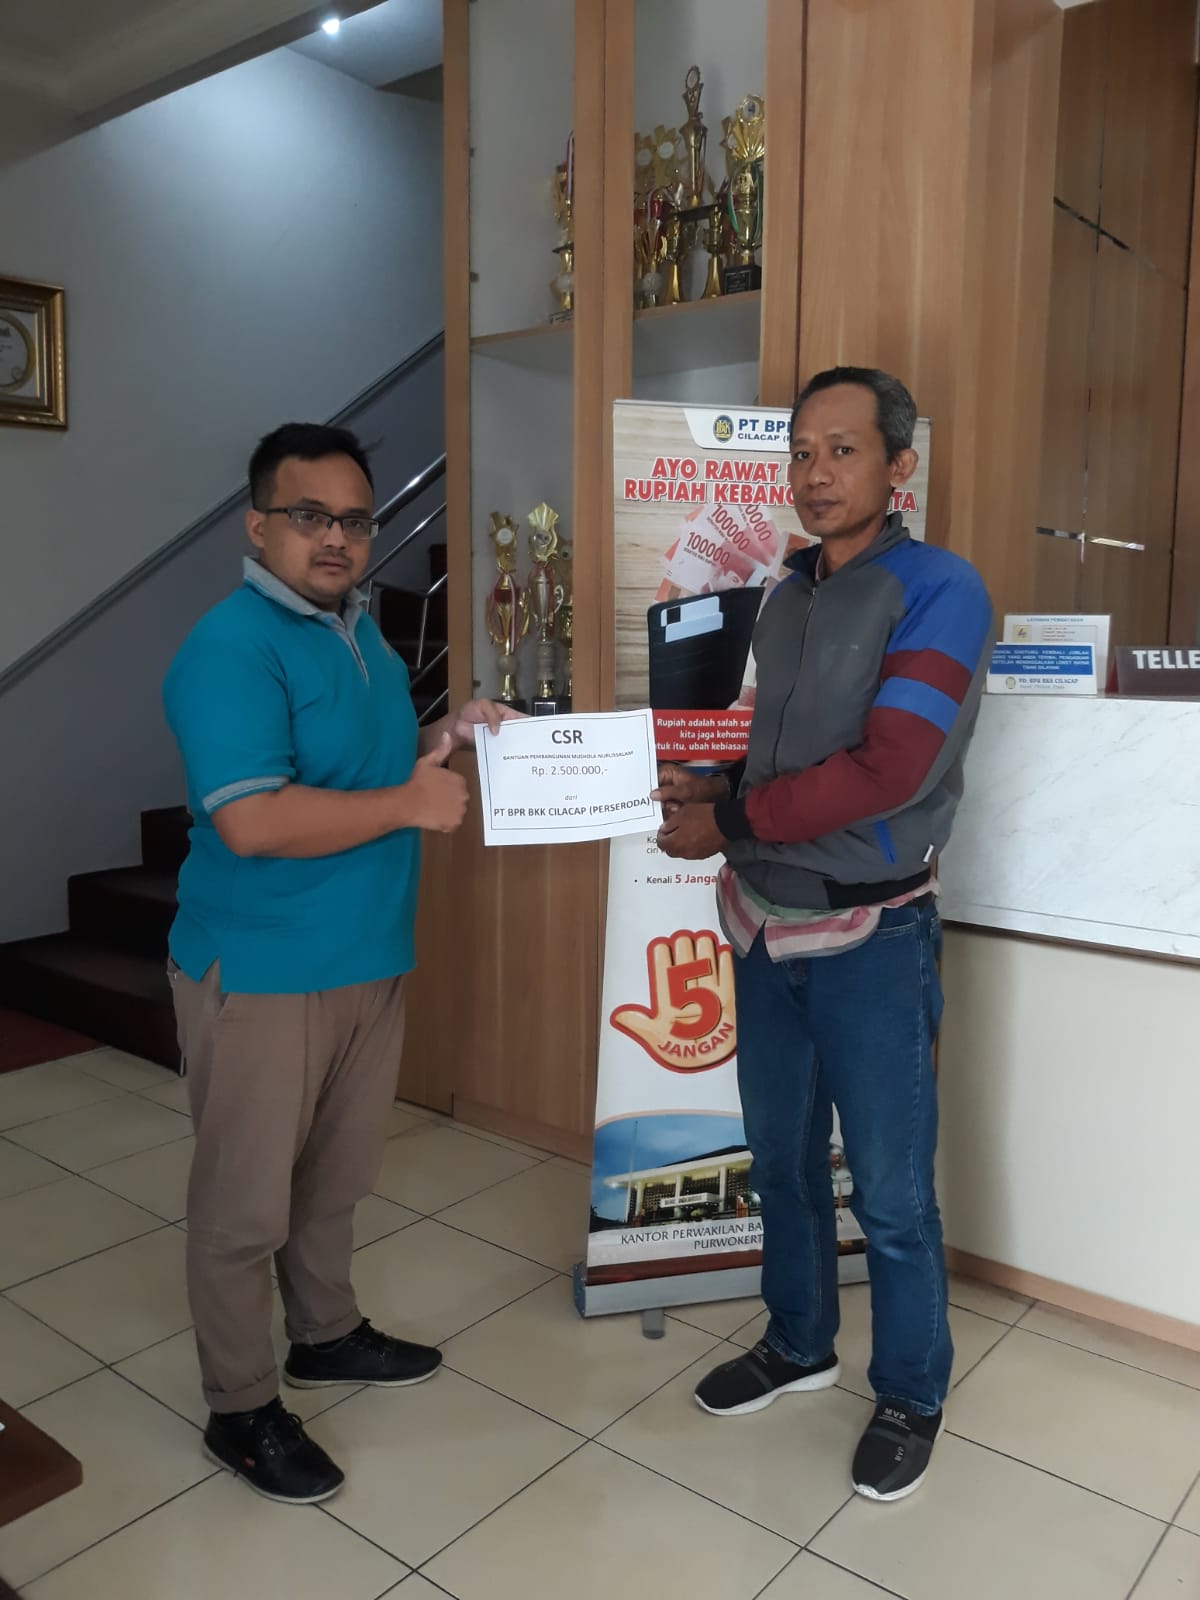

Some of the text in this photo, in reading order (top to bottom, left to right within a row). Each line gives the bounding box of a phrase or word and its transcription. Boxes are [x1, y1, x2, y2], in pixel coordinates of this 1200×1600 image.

[738, 418, 759, 432] PT
[737, 432, 780, 441] CILACAP
[651, 457, 698, 480] AYO
[705, 459, 780, 483] RAWAT
[624, 478, 706, 503] RUPIAH
[891, 490, 918, 512] TA
[711, 504, 750, 550] 100000
[745, 504, 772, 541] 0000
[687, 531, 730, 565] 100000
[1132, 650, 1200, 669] TELLE
[657, 718, 752, 728] Rupiah adalah salah sat
[551, 730, 583, 744] CSR
[680, 731, 696, 739] kita
[697, 731, 715, 740] jaga
[673, 743, 687, 751] itu,
[689, 742, 709, 750] ubah
[531, 765, 608, 777] Rp. 2.500.000,-
[494, 796, 650, 817] PT BPR BKK CILACAP (PERSERODA)
[646, 874, 718, 885] Kenali 5 Janga
[667, 958, 722, 1041] 5
[657, 1022, 735, 1059] JANGAN
[621, 1221, 763, 1245] KANTOR PERWAKILAN BA
[694, 1233, 764, 1250] PURWOKERT
[884, 1407, 906, 1420] MVP
